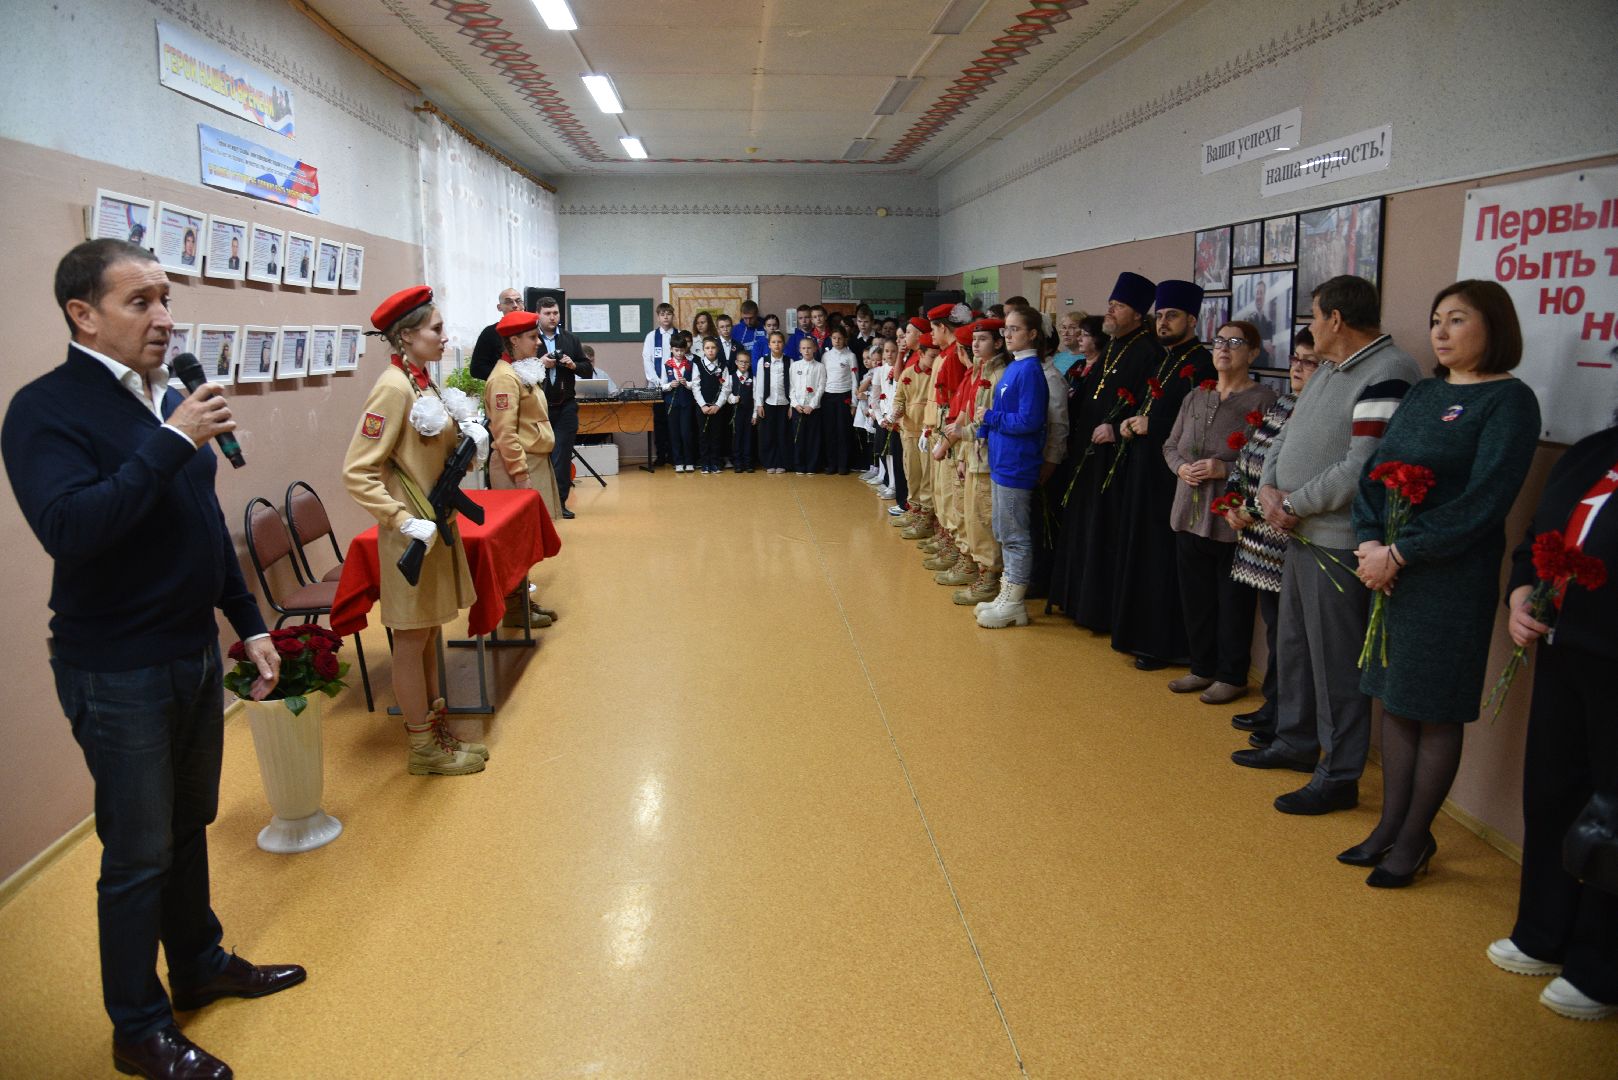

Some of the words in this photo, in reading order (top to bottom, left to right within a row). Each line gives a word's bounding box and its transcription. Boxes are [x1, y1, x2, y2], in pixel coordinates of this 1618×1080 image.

[1206, 141, 1236, 164] Ваши
[1236, 124, 1282, 160] успехи
[1265, 160, 1301, 185] наша
[1305, 131, 1386, 178] гордость!
[1475, 197, 1618, 246] Первы
[1495, 243, 1596, 282] быть
[1539, 285, 1585, 315] но
